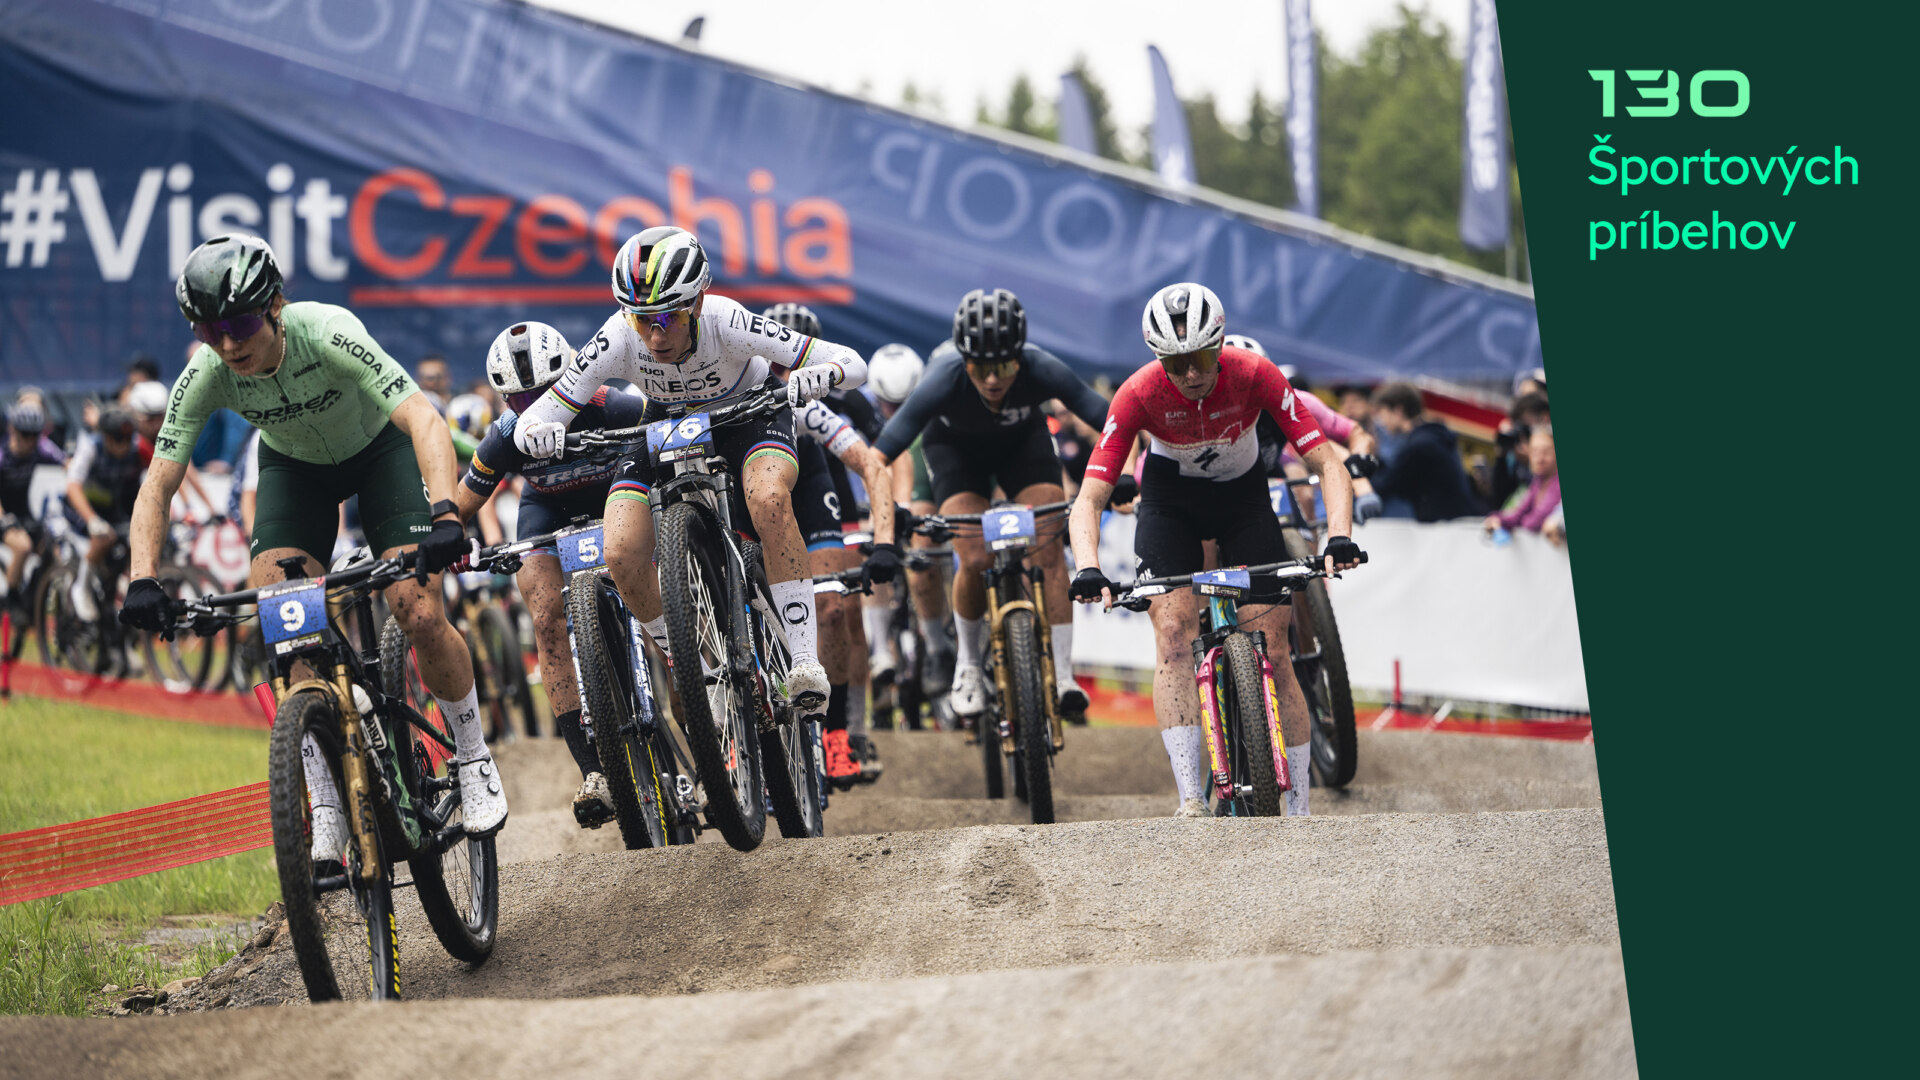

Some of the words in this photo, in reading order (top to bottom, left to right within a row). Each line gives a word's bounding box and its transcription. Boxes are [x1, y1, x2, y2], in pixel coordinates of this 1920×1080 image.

[729, 309, 791, 342] INEOS
[565, 330, 610, 387] INEOS
[644, 367, 665, 377] UCI
[644, 371, 722, 394] INEOS
[381, 375, 408, 400] FOX
[241, 389, 341, 420] ORBEA
[614, 428, 640, 436] MOST
[657, 417, 703, 444] 16
[766, 429, 791, 441] GOBIK
[999, 513, 1020, 536] 2
[578, 536, 600, 563] 5
[1212, 571, 1227, 582] 1
[279, 600, 306, 632] 9
